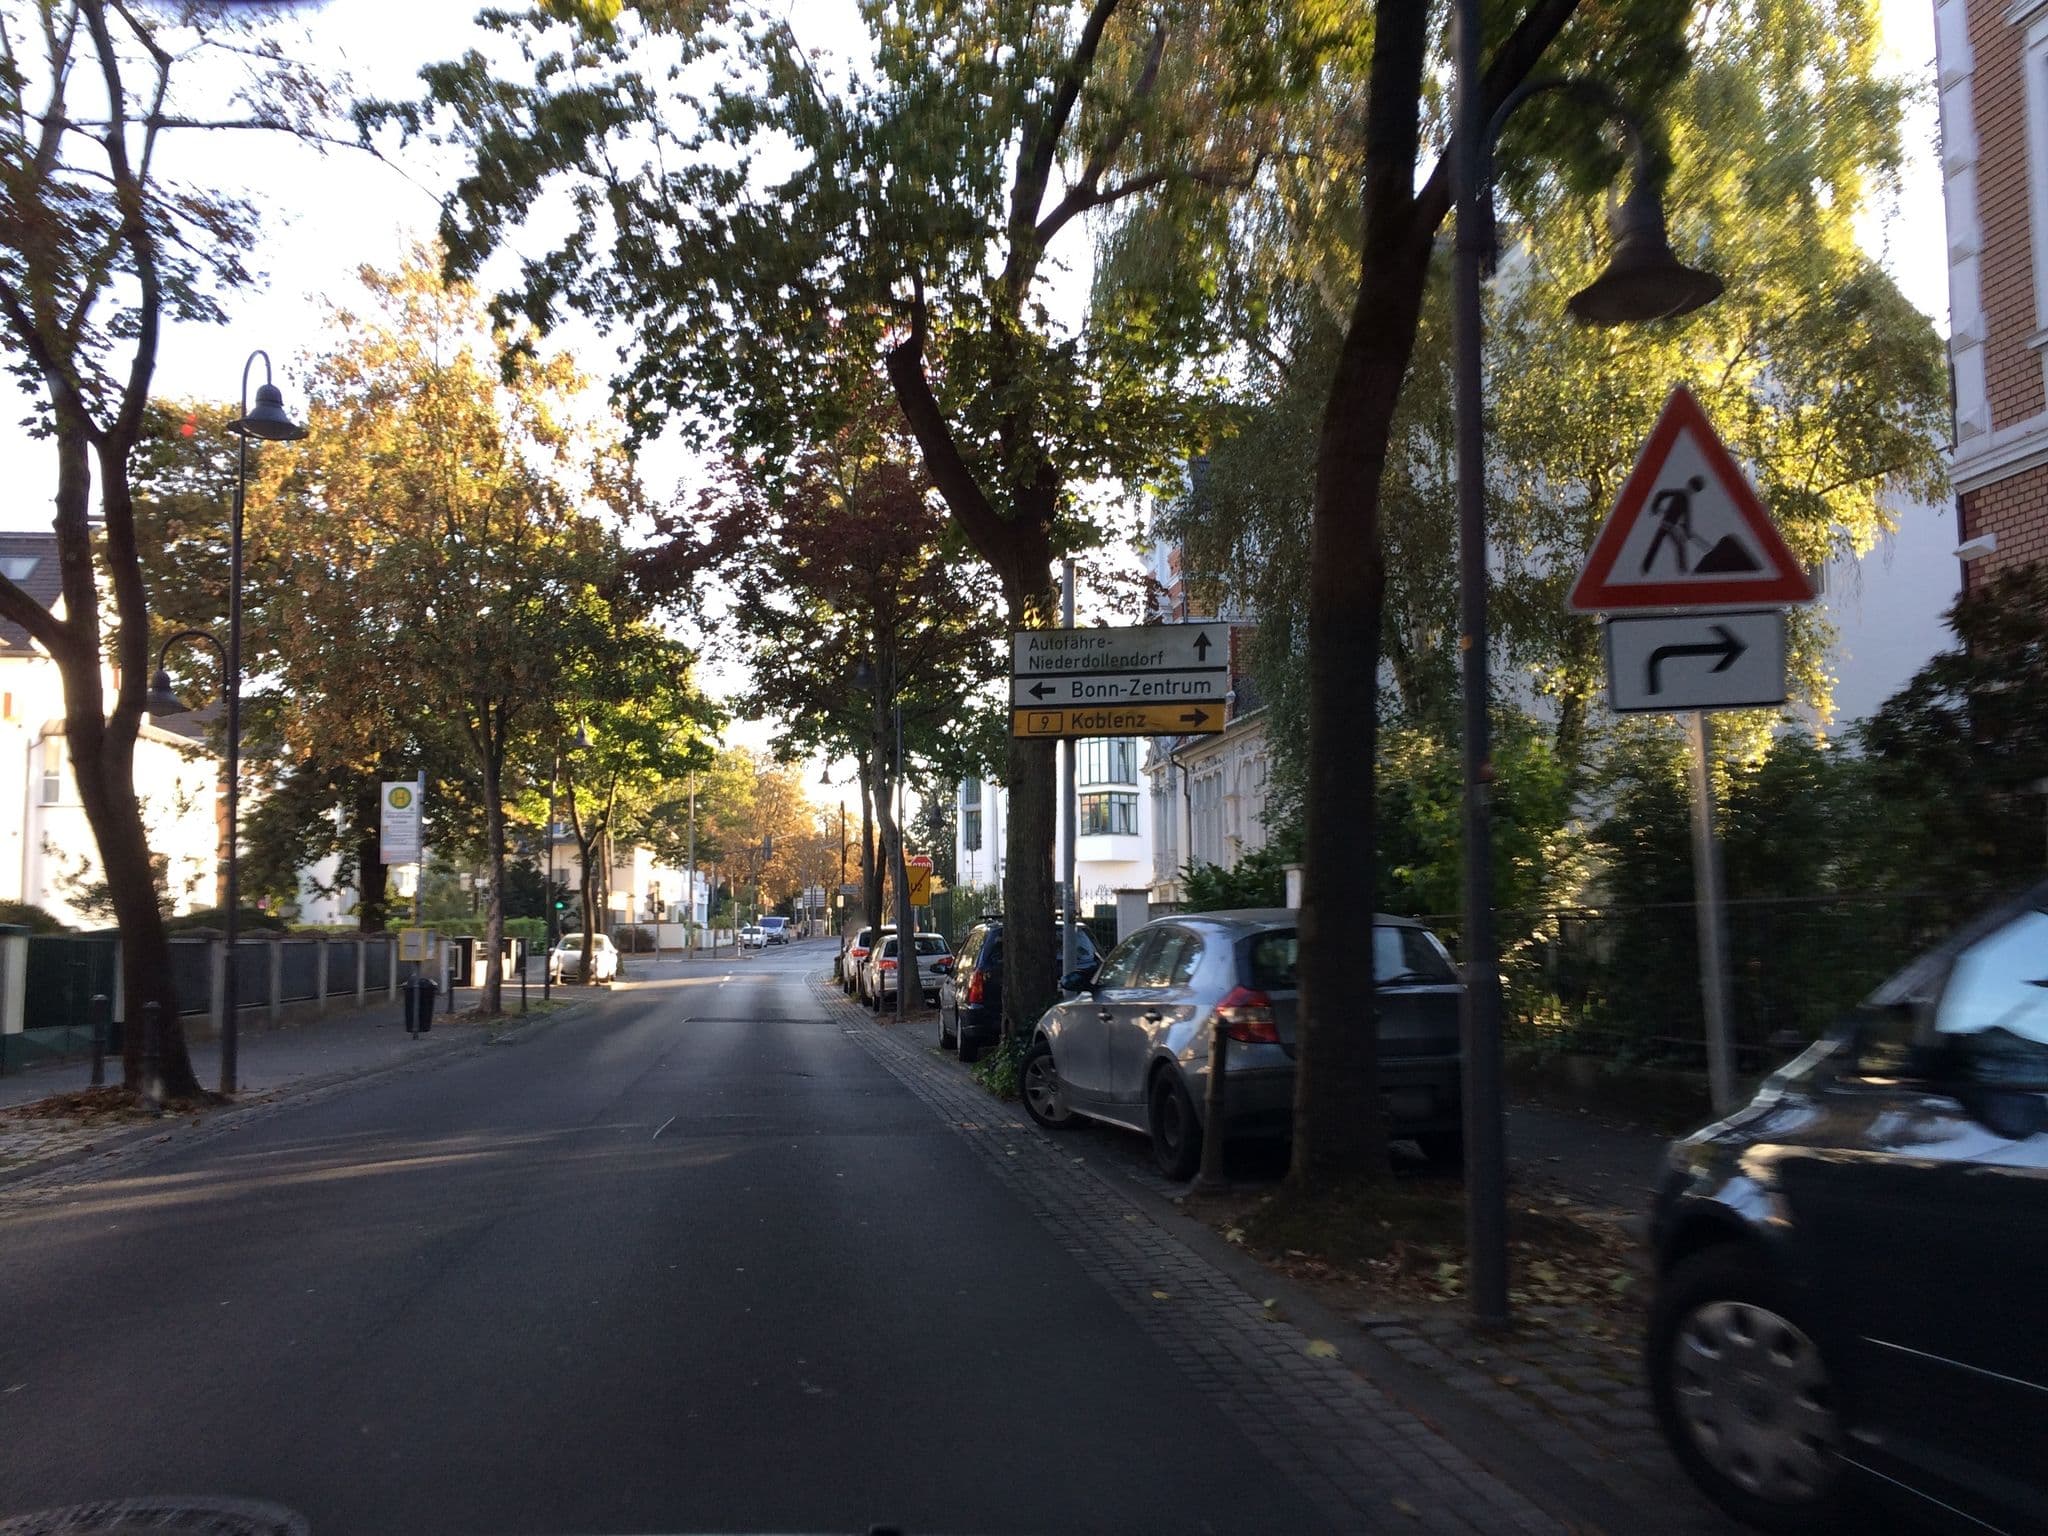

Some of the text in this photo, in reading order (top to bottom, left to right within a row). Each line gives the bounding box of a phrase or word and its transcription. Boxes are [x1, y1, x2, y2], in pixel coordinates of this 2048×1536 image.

[1029, 650, 1164, 670] Niederdollendorf
[1072, 679, 1211, 698] Bonn-Zentrum
[1072, 713, 1146, 730] Koblenz
